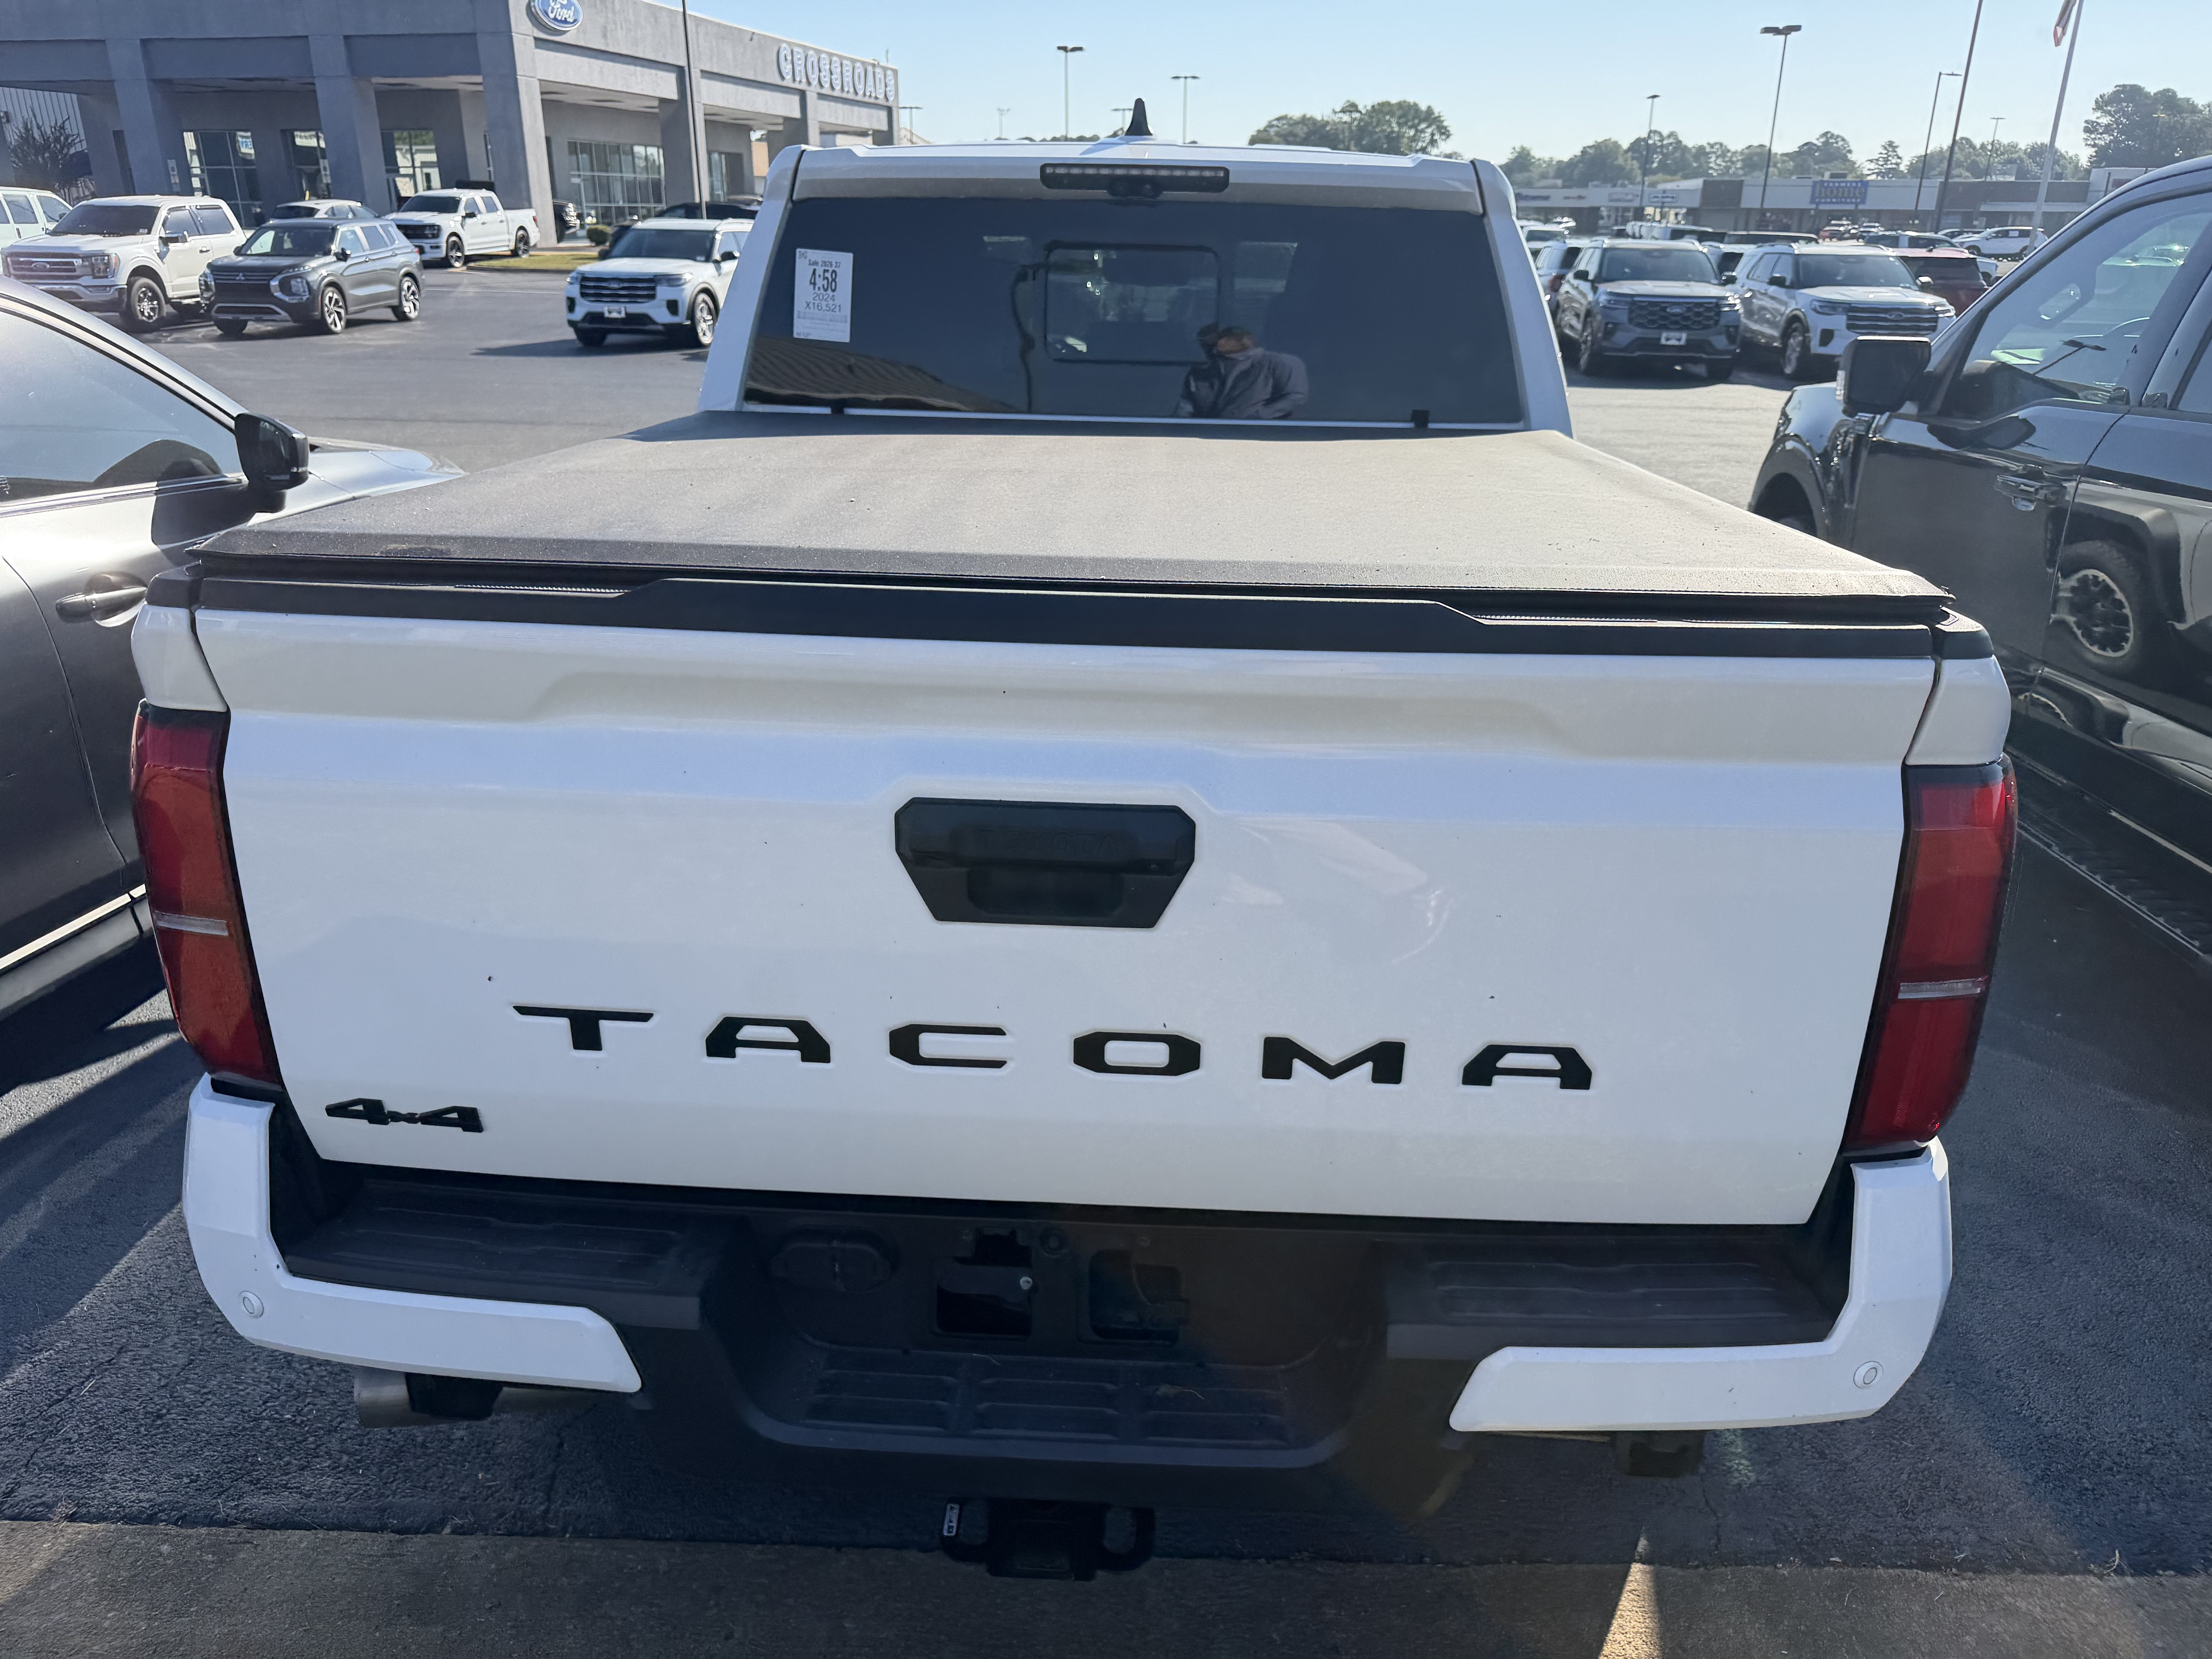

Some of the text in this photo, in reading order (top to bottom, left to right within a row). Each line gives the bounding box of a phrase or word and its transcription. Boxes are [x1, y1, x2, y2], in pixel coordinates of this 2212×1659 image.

[548, 0, 574, 22] Ford
[779, 43, 895, 101] CROSSROADS
[809, 268, 837, 293] 4:58
[805, 301, 842, 313] X16,521
[813, 292, 835, 302] 2024
[979, 830, 1120, 852] TOYOTA
[513, 1005, 1593, 1090] TACOMA
